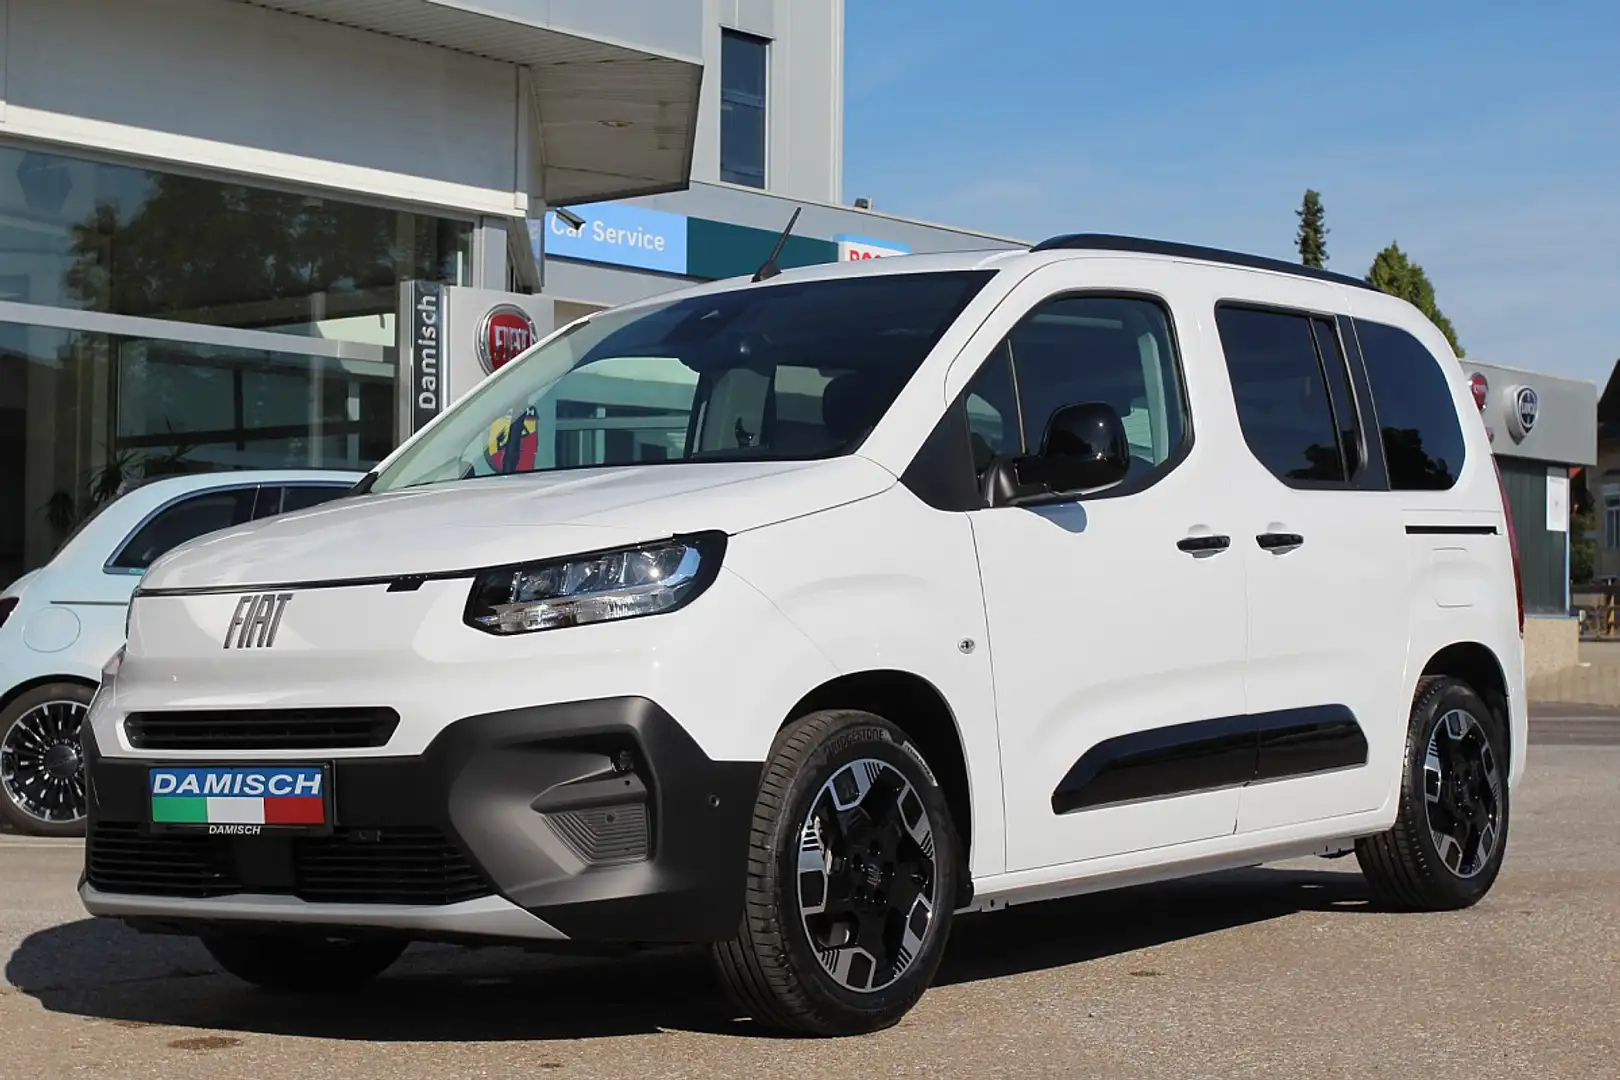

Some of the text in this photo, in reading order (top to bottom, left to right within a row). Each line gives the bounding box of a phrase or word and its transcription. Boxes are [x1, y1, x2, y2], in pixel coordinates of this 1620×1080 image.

[592, 220, 665, 252] Service
[417, 295, 437, 410] Damisch
[494, 325, 529, 351] FIAT
[223, 593, 294, 649] FIAT
[153, 773, 322, 795] DAMISCH
[208, 825, 262, 836] DAMISCH
